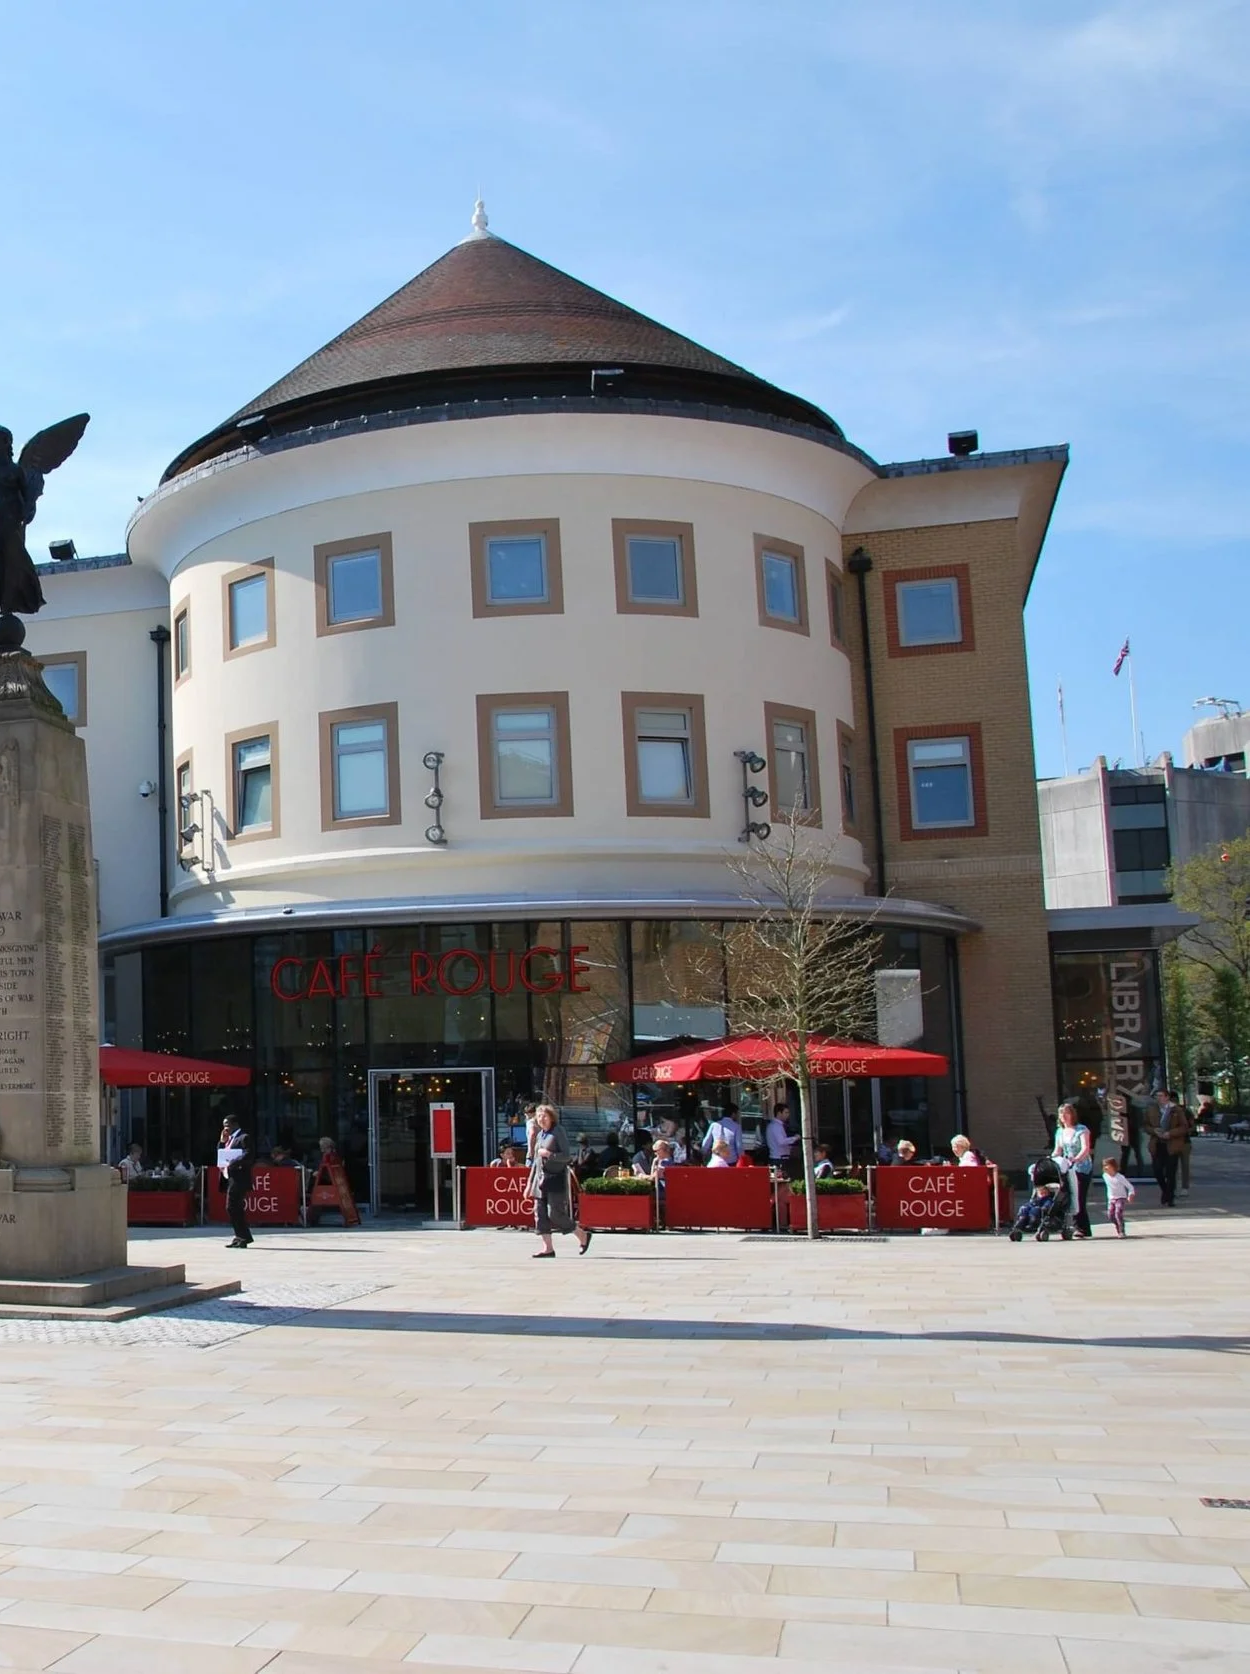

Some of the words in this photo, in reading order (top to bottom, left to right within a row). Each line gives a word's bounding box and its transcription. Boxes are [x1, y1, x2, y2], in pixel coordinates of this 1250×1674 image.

[17, 956, 34, 964] MEN
[10, 969, 34, 977] TOWN
[270, 944, 383, 1001] CAFÉ
[410, 946, 591, 995] ROUGE
[4, 995, 15, 1003] OF
[17, 994, 34, 1002] WAR
[1110, 962, 1146, 1101] LIBRARY
[632, 1065, 648, 1080] CAFÉ
[826, 1060, 867, 1073] ROUGE
[148, 1070, 175, 1084] CAFÉ
[177, 1071, 210, 1084] ROUGE
[494, 1177, 528, 1192] CAF
[908, 1173, 955, 1193] CAFÉ
[486, 1199, 534, 1215] ROUG
[900, 1200, 965, 1217] ROUGE
